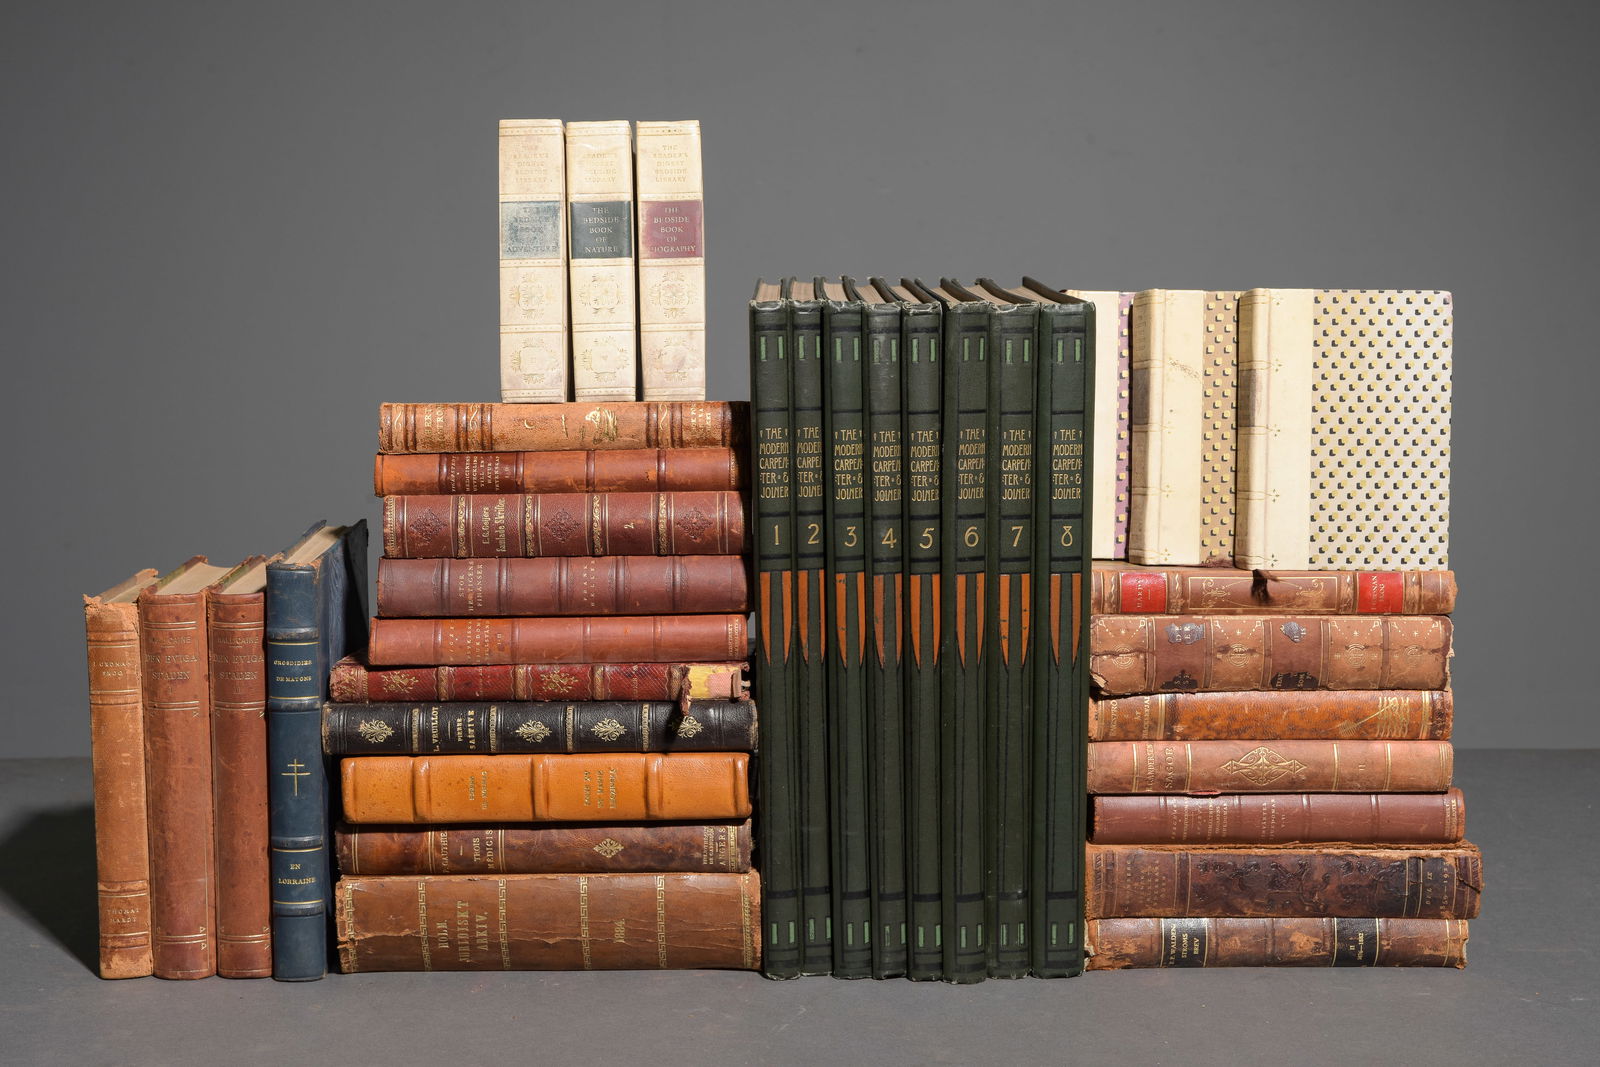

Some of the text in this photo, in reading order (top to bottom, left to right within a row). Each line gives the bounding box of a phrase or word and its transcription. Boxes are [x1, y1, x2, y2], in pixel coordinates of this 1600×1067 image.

[593, 206, 610, 214] THE
[583, 215, 620, 224] BEDSIDE
[653, 215, 691, 224] BEDSIDE
[588, 225, 613, 233] BOOK
[660, 225, 685, 233] BOOK
[584, 245, 619, 254] NATURE
[766, 427, 783, 440] THE
[802, 426, 820, 439] THE
[840, 428, 858, 441] THE
[879, 430, 896, 443] THE
[916, 430, 934, 443] THE
[965, 428, 981, 441] THE
[1009, 429, 1027, 441] THE
[1059, 428, 1077, 441] THE
[759, 442, 790, 455] MODERN
[796, 441, 822, 454] MODER
[910, 444, 940, 458] MODERN
[1002, 443, 1032, 456] MODERN
[1052, 443, 1083, 456] MODERN
[796, 456, 821, 469] CARPE
[760, 486, 790, 499] JOINER
[798, 486, 822, 498] JOINE
[835, 487, 863, 501] JOINER
[873, 488, 902, 502] JOINER
[911, 488, 940, 502] JOINER
[957, 487, 985, 500] JOINER
[1001, 487, 1031, 500] JOINER
[1052, 487, 1081, 500] JOINER
[772, 523, 782, 546] 1
[807, 522, 820, 544] 2
[844, 525, 858, 548] 3
[881, 527, 898, 549] 4
[919, 527, 935, 549] 5
[963, 525, 980, 548] 6
[1010, 525, 1024, 548] 7
[1060, 525, 1073, 547] 8
[467, 560, 475, 612] HETIGENS
[151, 671, 191, 681] STADEN
[1163, 747, 1175, 789] SAGOR
[440, 831, 449, 867] GAUTHIE
[472, 837, 481, 862] TROIS
[485, 830, 495, 869] MÉDICIS
[719, 827, 727, 866] ANGERS
[289, 862, 302, 870] EN
[278, 876, 318, 886] LORRAINE
[475, 911, 489, 951] ARKIV.
